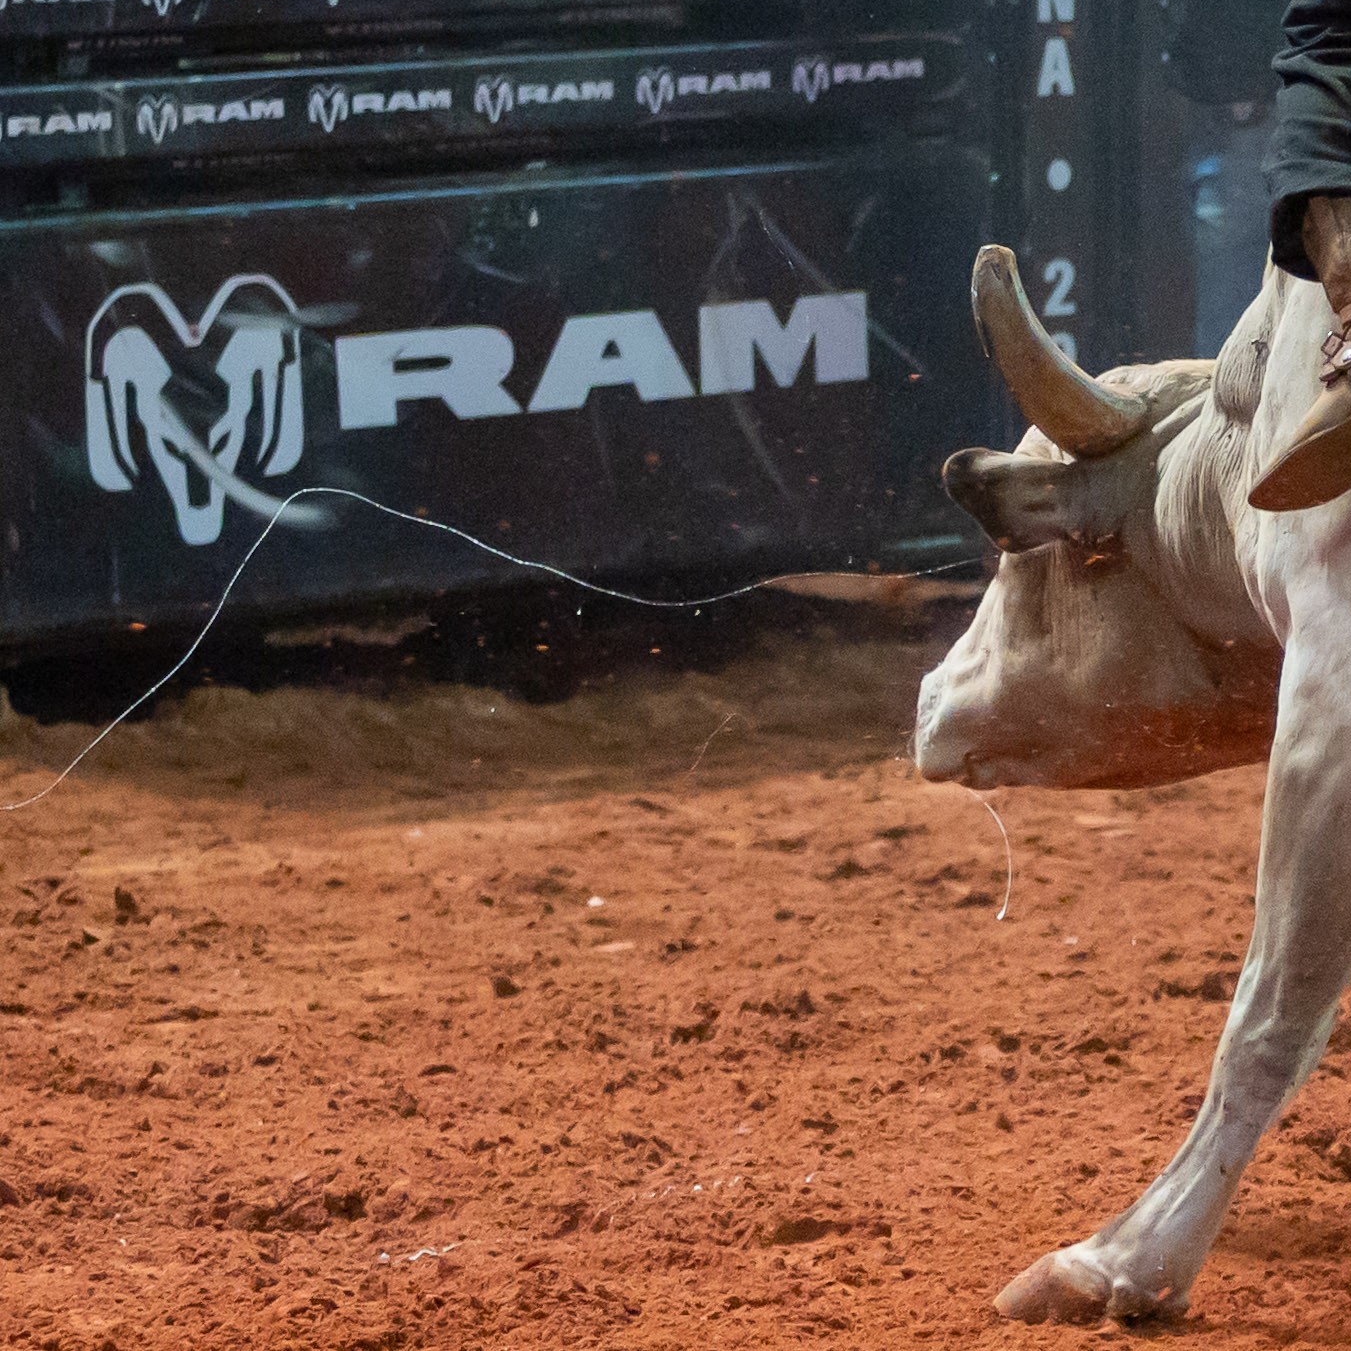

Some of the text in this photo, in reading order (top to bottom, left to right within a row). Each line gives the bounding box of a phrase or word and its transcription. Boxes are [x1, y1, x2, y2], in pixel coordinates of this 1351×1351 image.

[7, 58, 925, 137] RAM RAM RAM RAM RAM RAM
[335, 291, 870, 431] RAM
